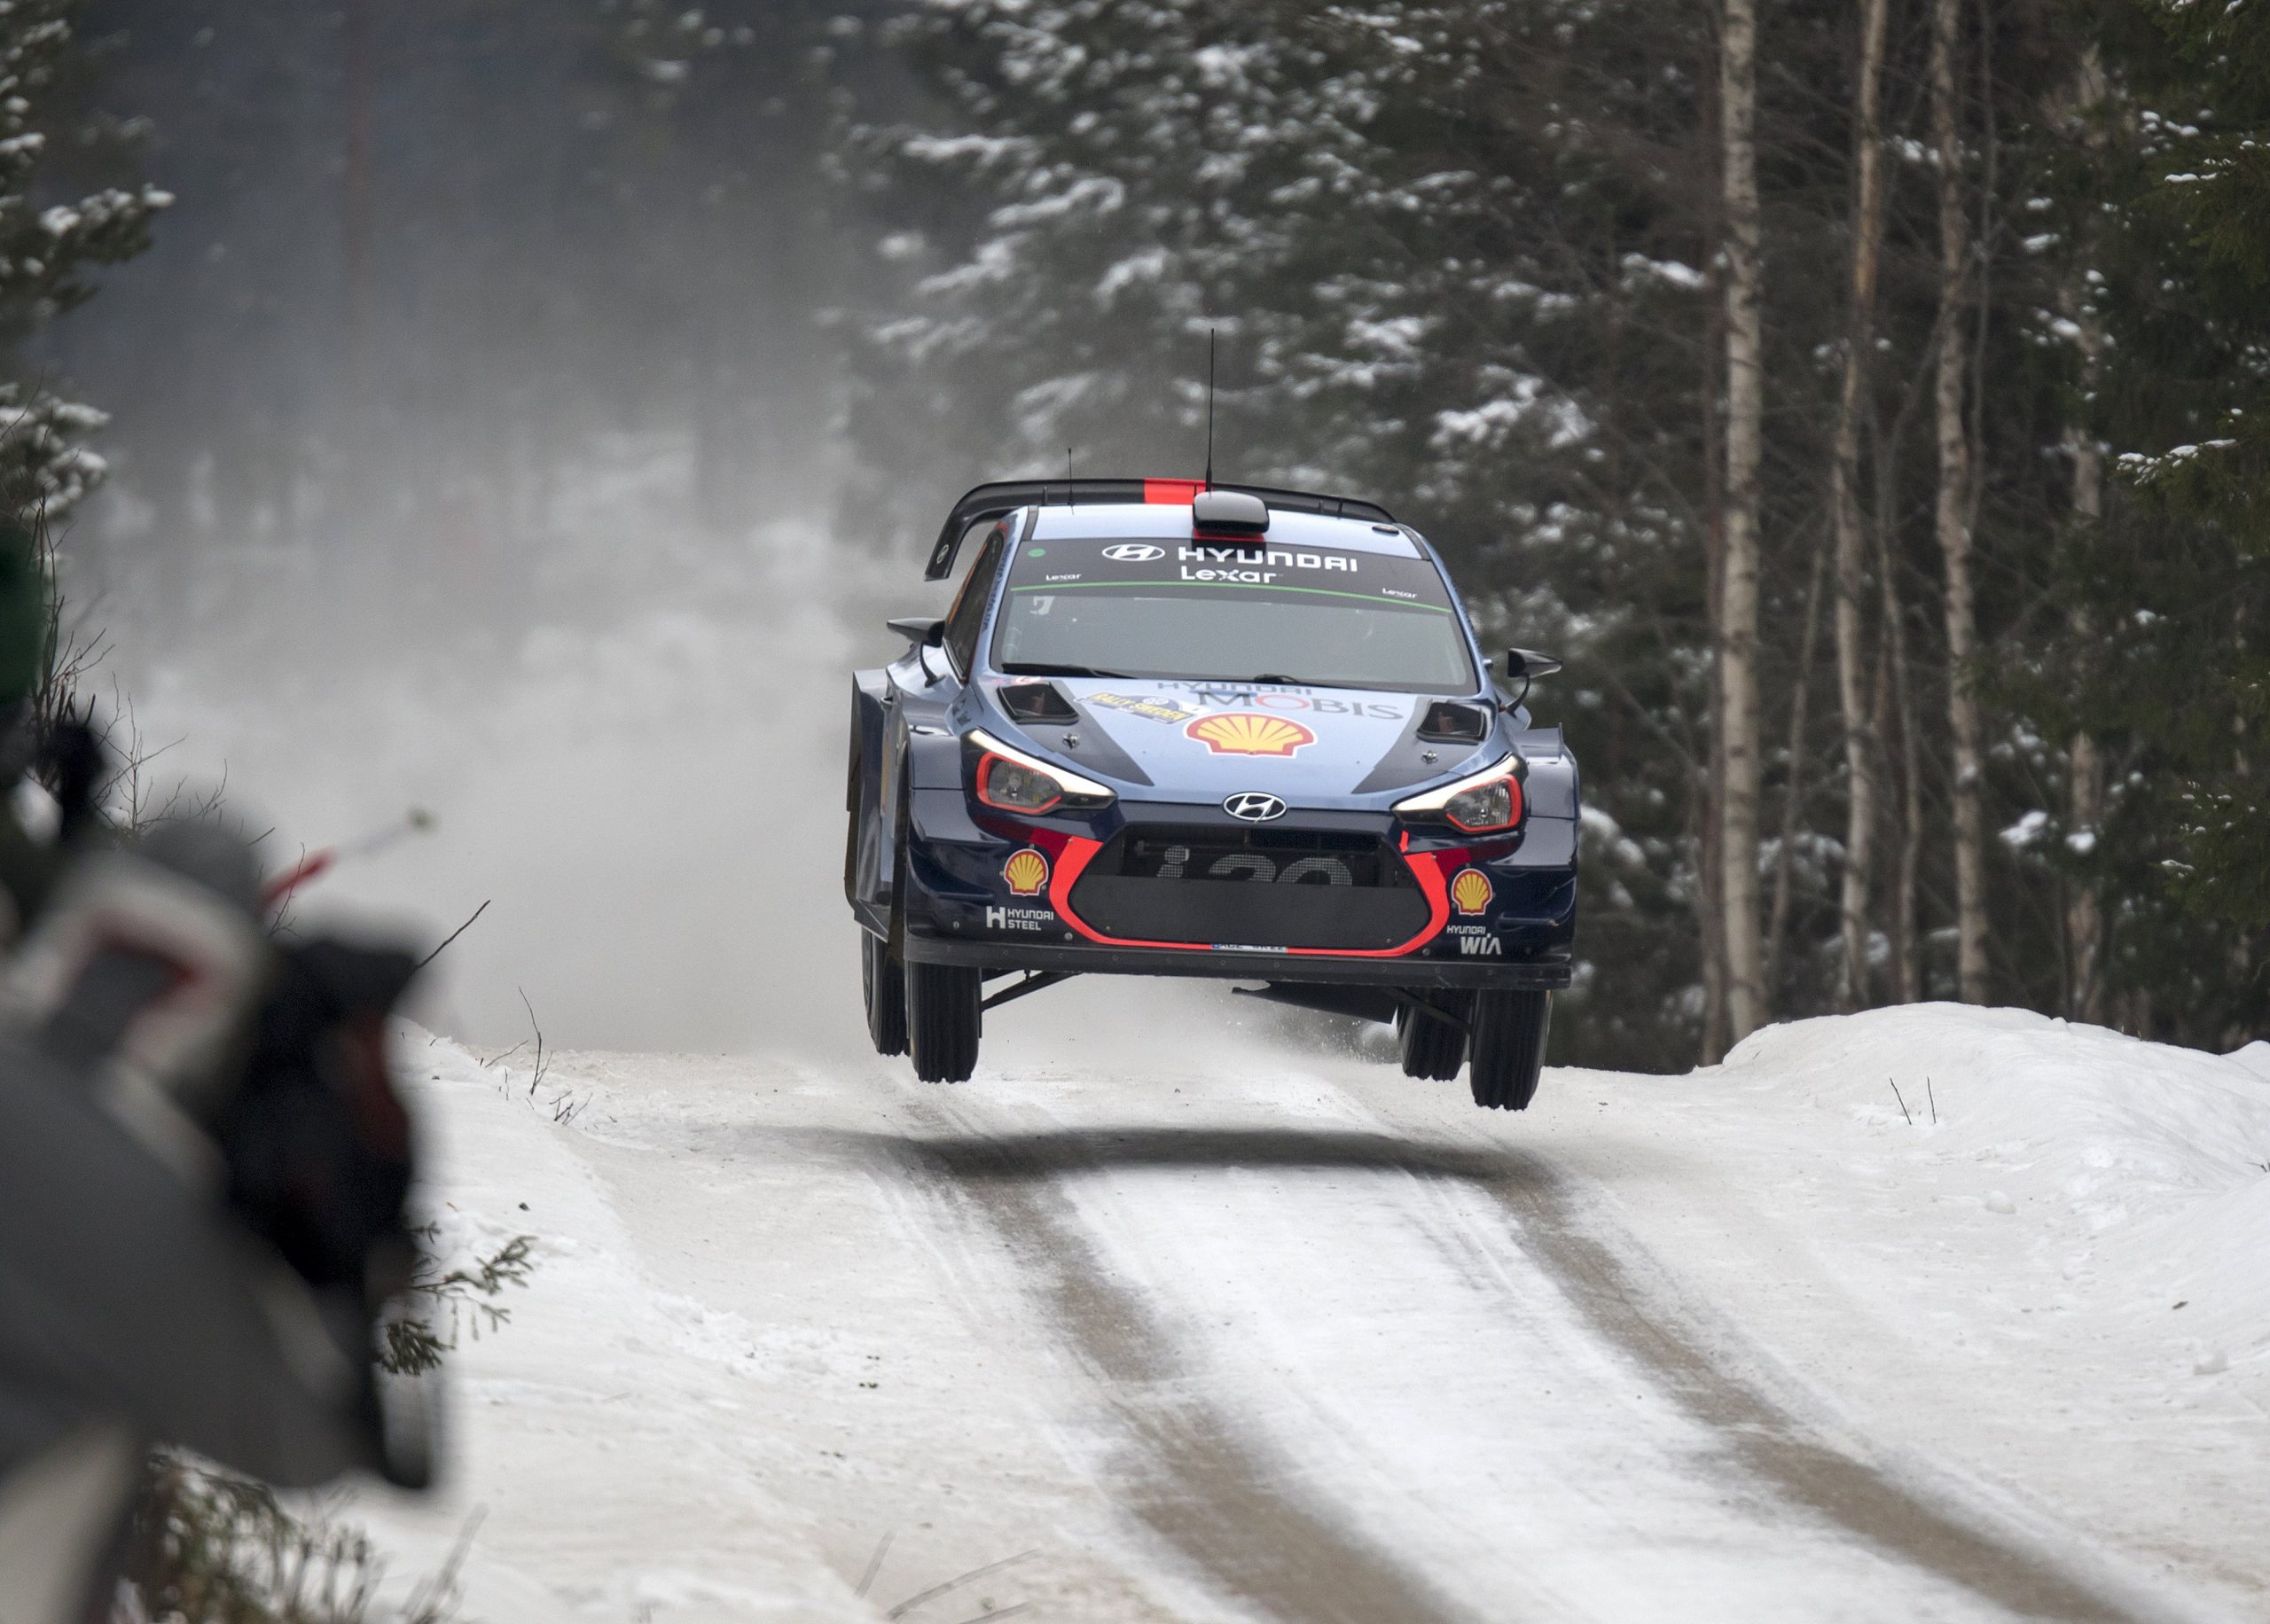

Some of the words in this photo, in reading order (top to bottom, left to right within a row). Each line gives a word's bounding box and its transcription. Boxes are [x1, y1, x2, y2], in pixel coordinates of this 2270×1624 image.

[1178, 546, 1358, 572] HYUNDAI
[1181, 566, 1277, 583] Lexar
[1382, 588, 1418, 598] Lexar
[1157, 682, 1312, 696] HYUNDAI
[1198, 691, 1405, 720] MOBIS
[1007, 908, 1054, 920] HYUNDAI
[1007, 918, 1042, 931] STEEL
[1446, 925, 1486, 934] HYUNDAI
